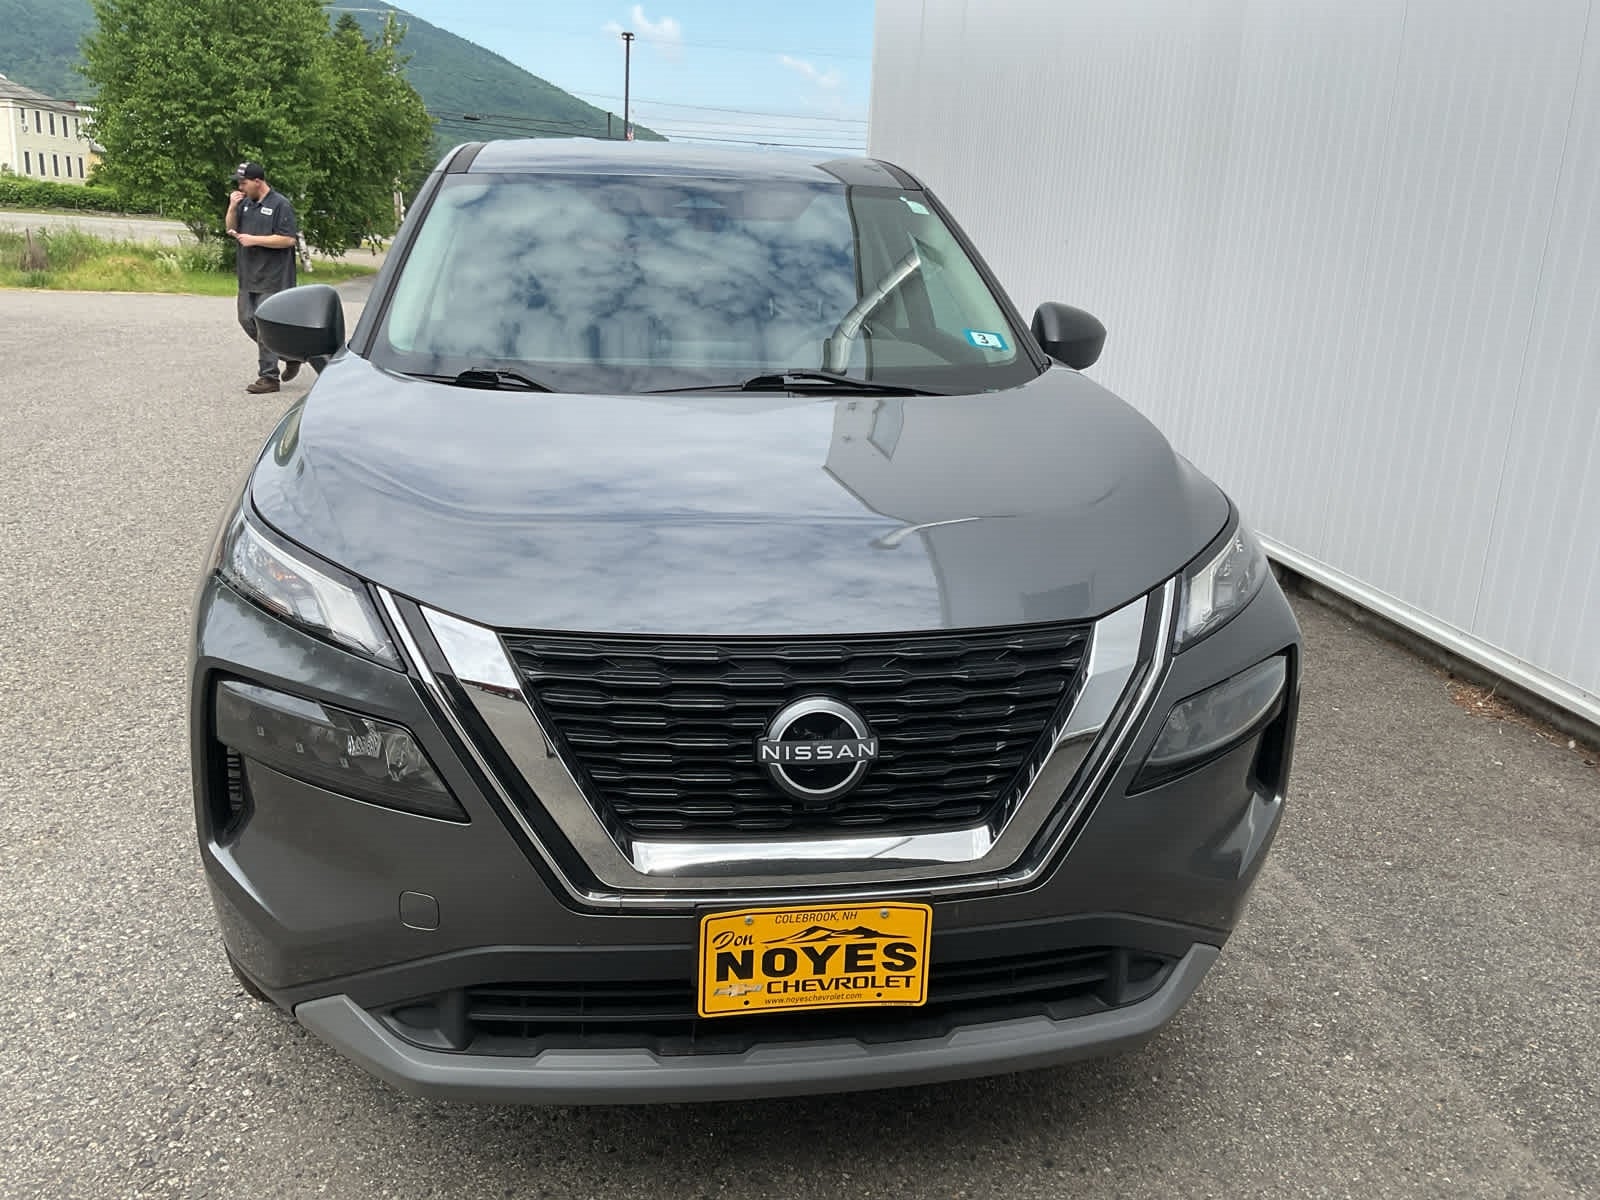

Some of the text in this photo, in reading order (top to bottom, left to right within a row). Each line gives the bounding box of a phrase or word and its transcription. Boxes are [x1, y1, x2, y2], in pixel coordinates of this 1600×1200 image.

[977, 334, 989, 344] 3
[762, 742, 875, 760] NISSAN
[775, 911, 858, 924] COLEBROOK, NH
[712, 931, 754, 950] Don
[715, 942, 917, 982] NOYES
[766, 975, 916, 994] CHEVROLET
[764, 992, 863, 1005] www.noyeschevrolet.com
